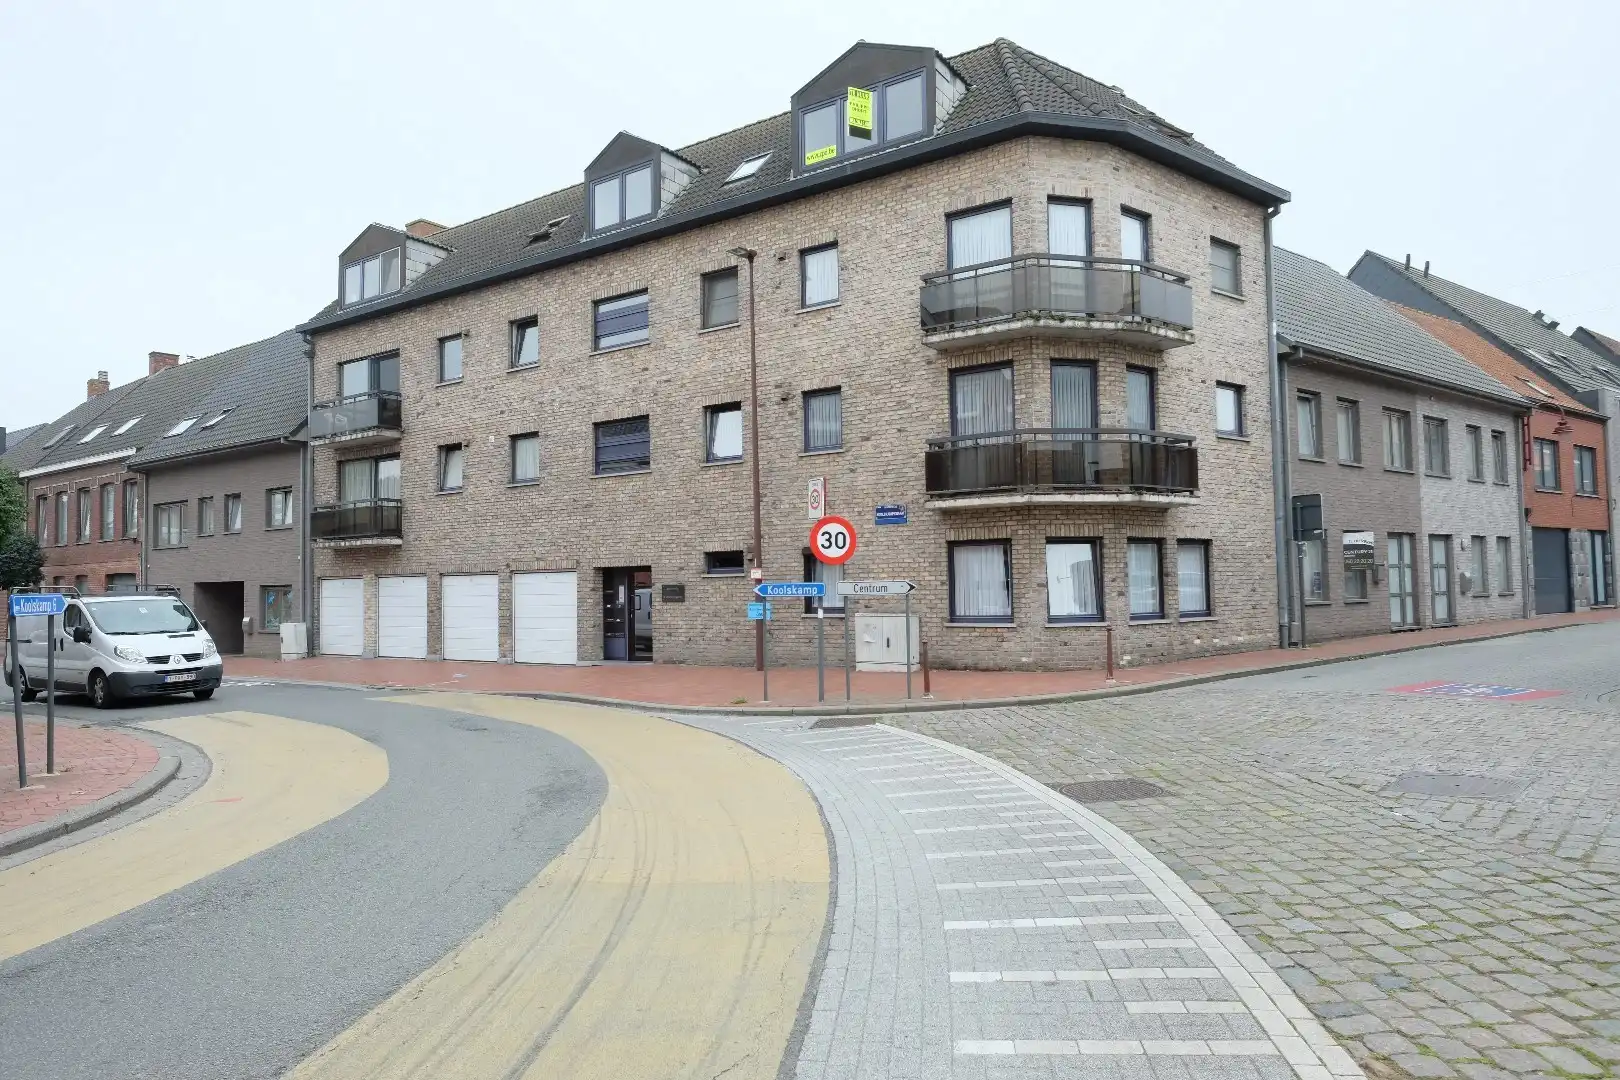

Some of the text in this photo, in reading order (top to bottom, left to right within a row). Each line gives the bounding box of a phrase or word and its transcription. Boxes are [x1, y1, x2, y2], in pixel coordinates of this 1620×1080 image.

[812, 494, 819, 505] 30
[820, 531, 847, 550] 30
[767, 585, 818, 596] Koolskamp
[853, 583, 888, 593] Centrum
[20, 598, 52, 613] Koolskamp
